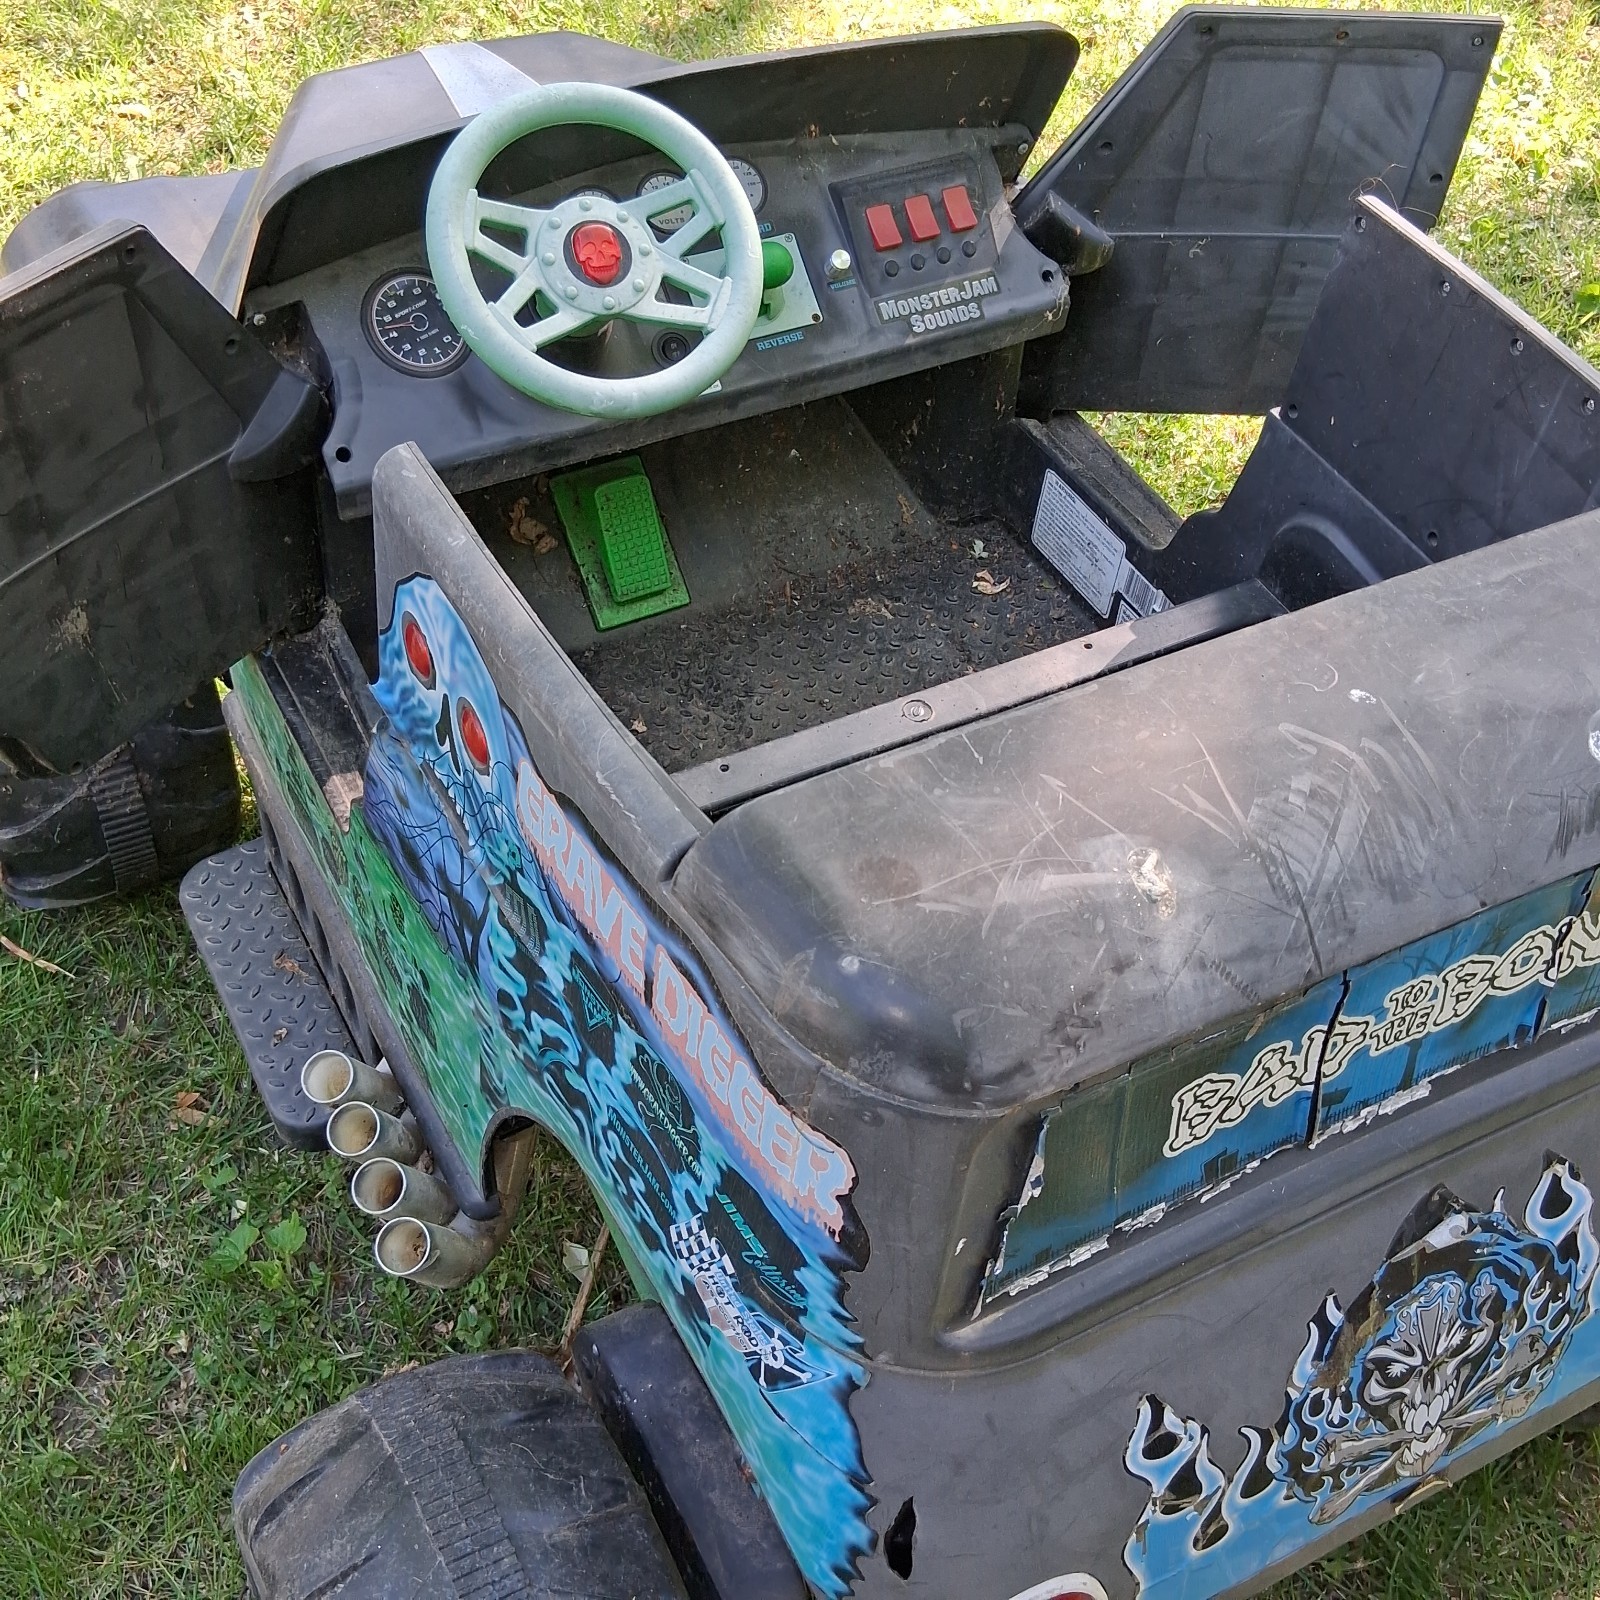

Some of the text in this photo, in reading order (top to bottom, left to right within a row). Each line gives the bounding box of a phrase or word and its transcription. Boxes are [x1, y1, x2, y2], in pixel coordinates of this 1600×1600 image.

[658, 217, 685, 225] VOLTS
[396, 289, 404, 297] 7
[909, 302, 981, 333] SOUNDS
[442, 335, 452, 343] 0
[756, 331, 804, 351] REVERSE
[417, 348, 427, 356] 2
[517, 758, 857, 1232] GRAVE DIGGER
[1384, 974, 1437, 1017] TO
[1369, 1004, 1435, 1056] THE
[1162, 1015, 1375, 1158] BAD
